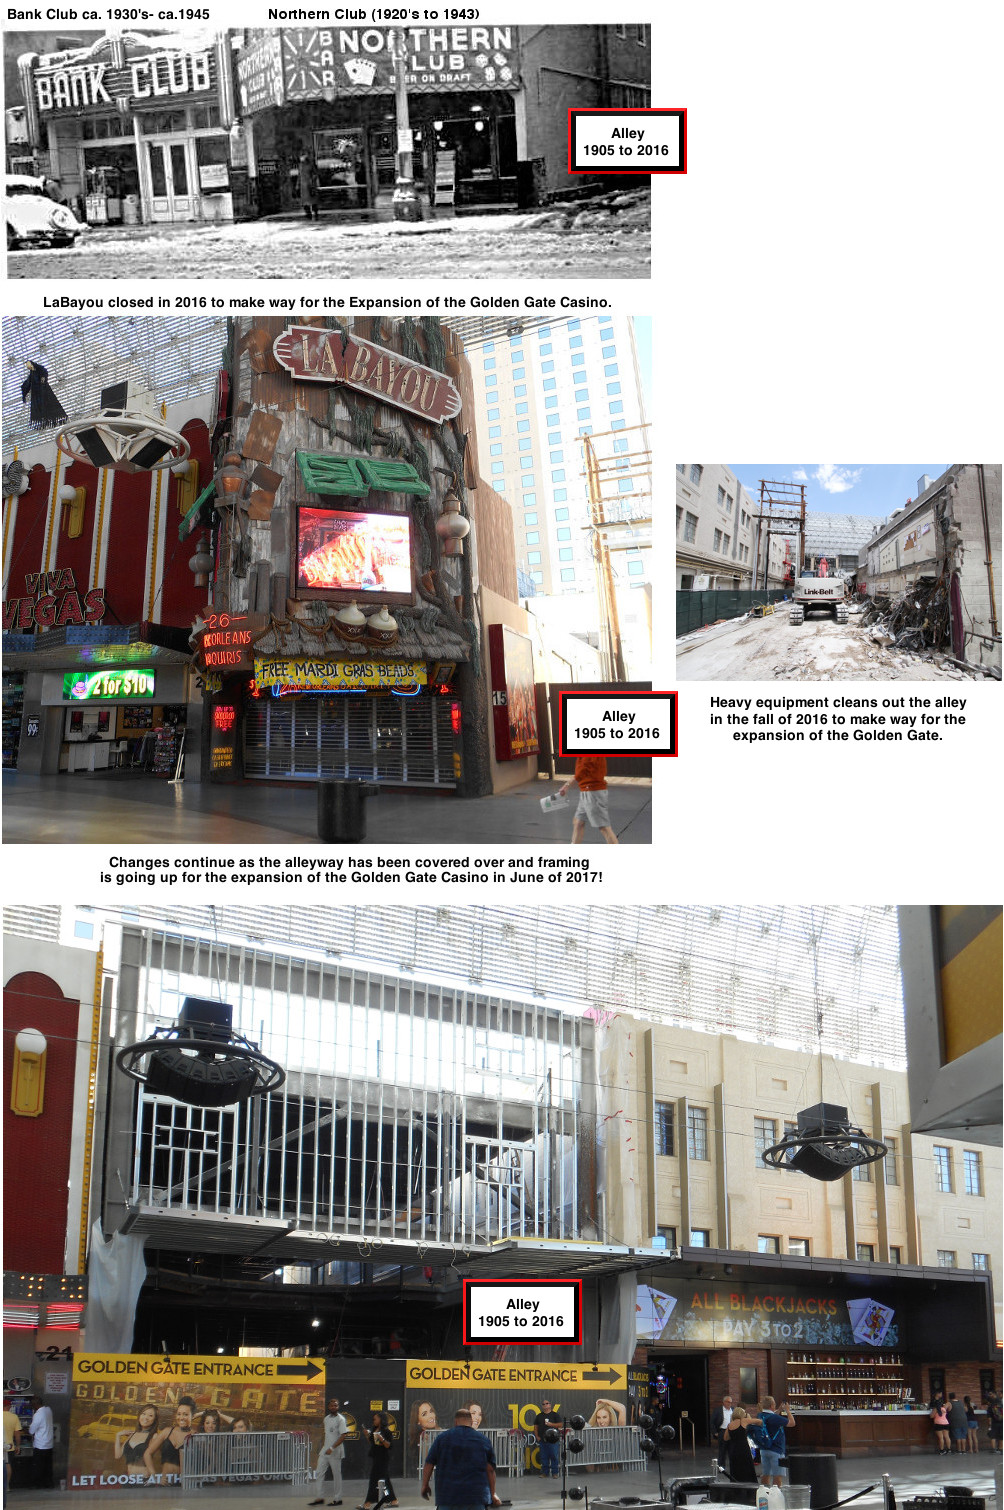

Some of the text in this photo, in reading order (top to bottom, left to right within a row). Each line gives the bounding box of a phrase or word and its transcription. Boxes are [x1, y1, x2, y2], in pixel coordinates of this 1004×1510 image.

[36, 51, 211, 110] BANK CLUB
[389, 73, 472, 84] BER ON DRAFT
[300, 333, 441, 411] LA BAYOU
[25, 567, 76, 594] VIVA
[804, 588, 834, 596] Link-Belt
[2, 588, 105, 630] VEGAS
[209, 613, 230, 629] 26
[262, 662, 290, 680] FREE
[294, 662, 339, 677] MARDI
[343, 664, 374, 678] GRAS
[92, 675, 148, 696] 2 for $10
[492, 691, 507, 706] 15
[690, 1291, 838, 1316] ALL BLACKJACKS
[722, 1319, 753, 1337] PAY
[760, 1320, 771, 1338] 3
[772, 1323, 792, 1337] TO
[78, 1359, 274, 1377] GOLDEN GATE ENTRANCE
[409, 1366, 578, 1383] GOLDEN GATE ENTRANCE
[76, 1383, 321, 1414] GOLDEN GATE
[508, 1403, 561, 1432] 10
[72, 1474, 97, 1487] LET
[99, 1473, 142, 1486] LOOSE
[147, 1473, 163, 1485] AT
[165, 1473, 187, 1485] TH
